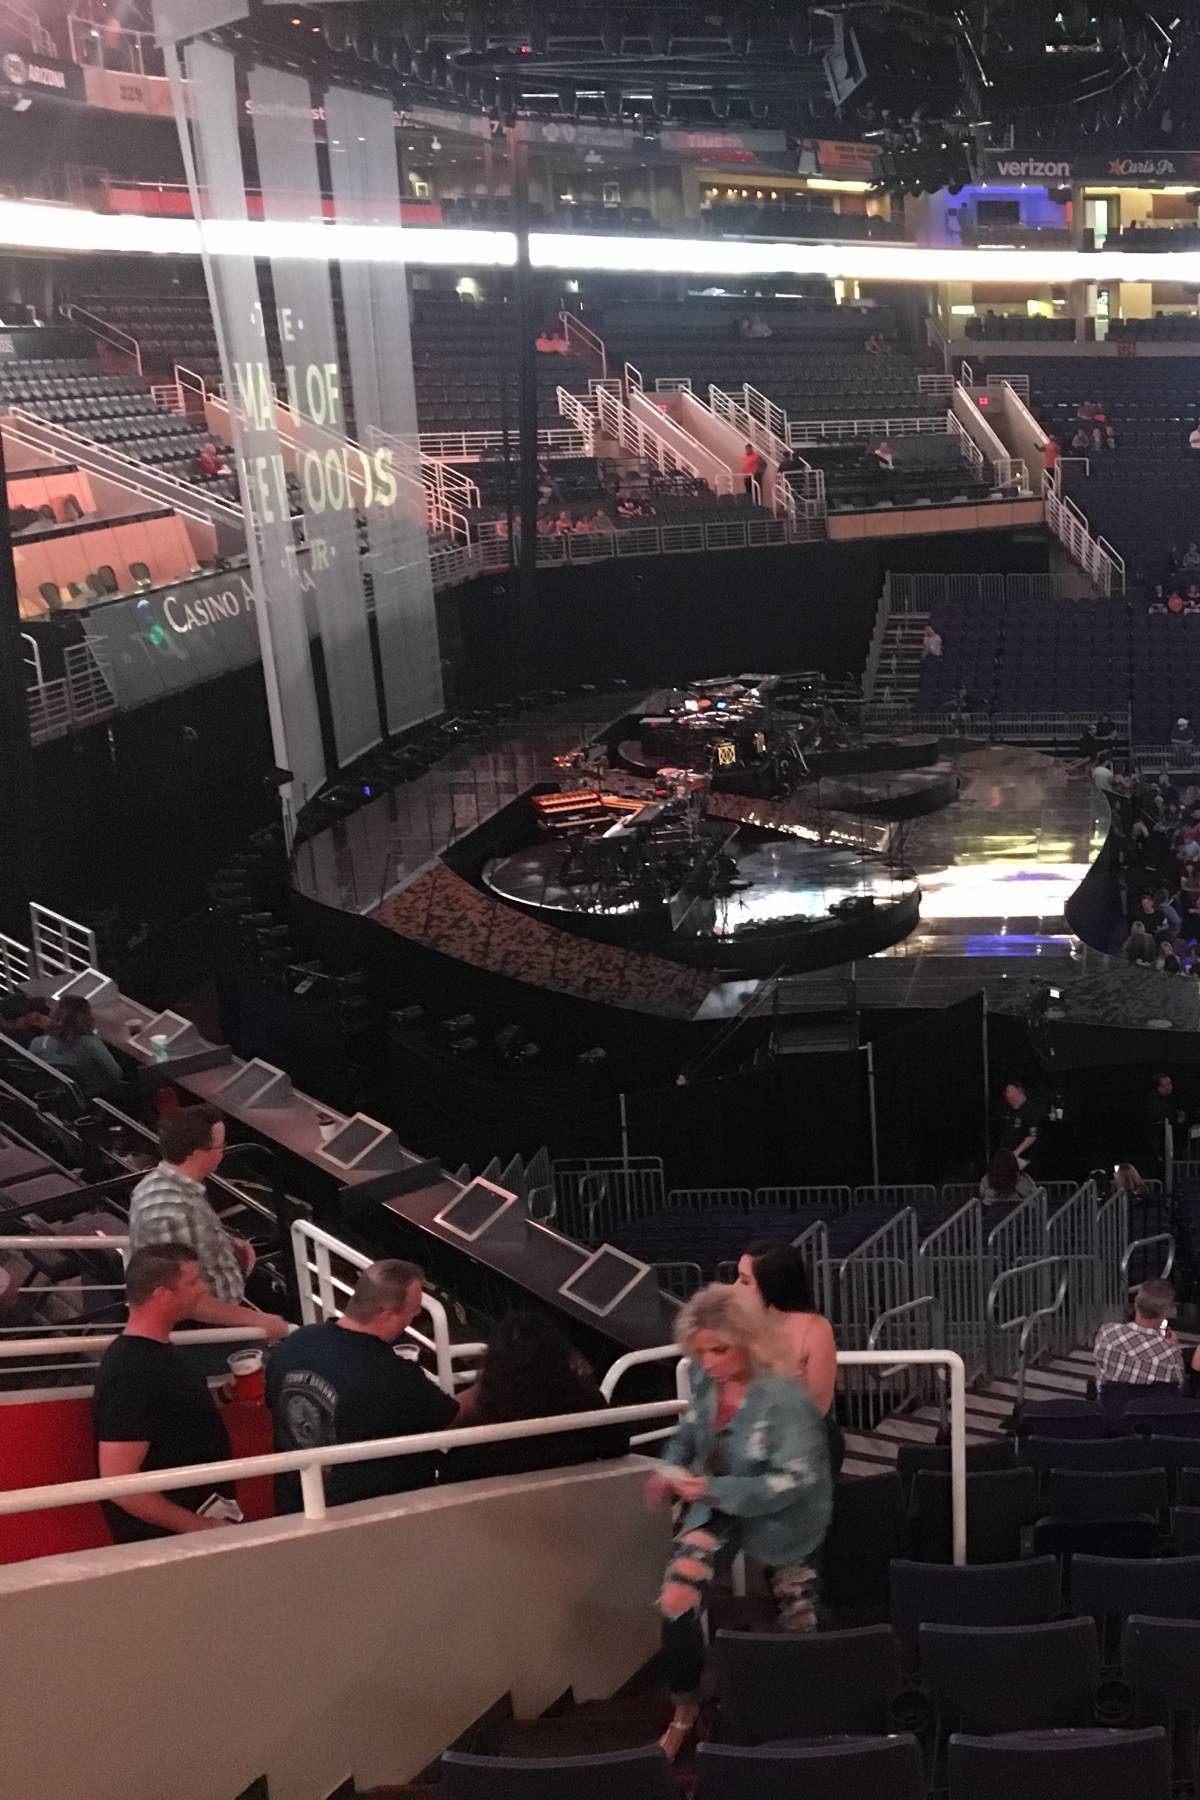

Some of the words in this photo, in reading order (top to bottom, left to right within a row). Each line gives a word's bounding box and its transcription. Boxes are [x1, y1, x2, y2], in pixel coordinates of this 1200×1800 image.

[996, 158, 1071, 177] verizon
[306, 363, 340, 425] OF
[163, 591, 240, 633] CASINO
